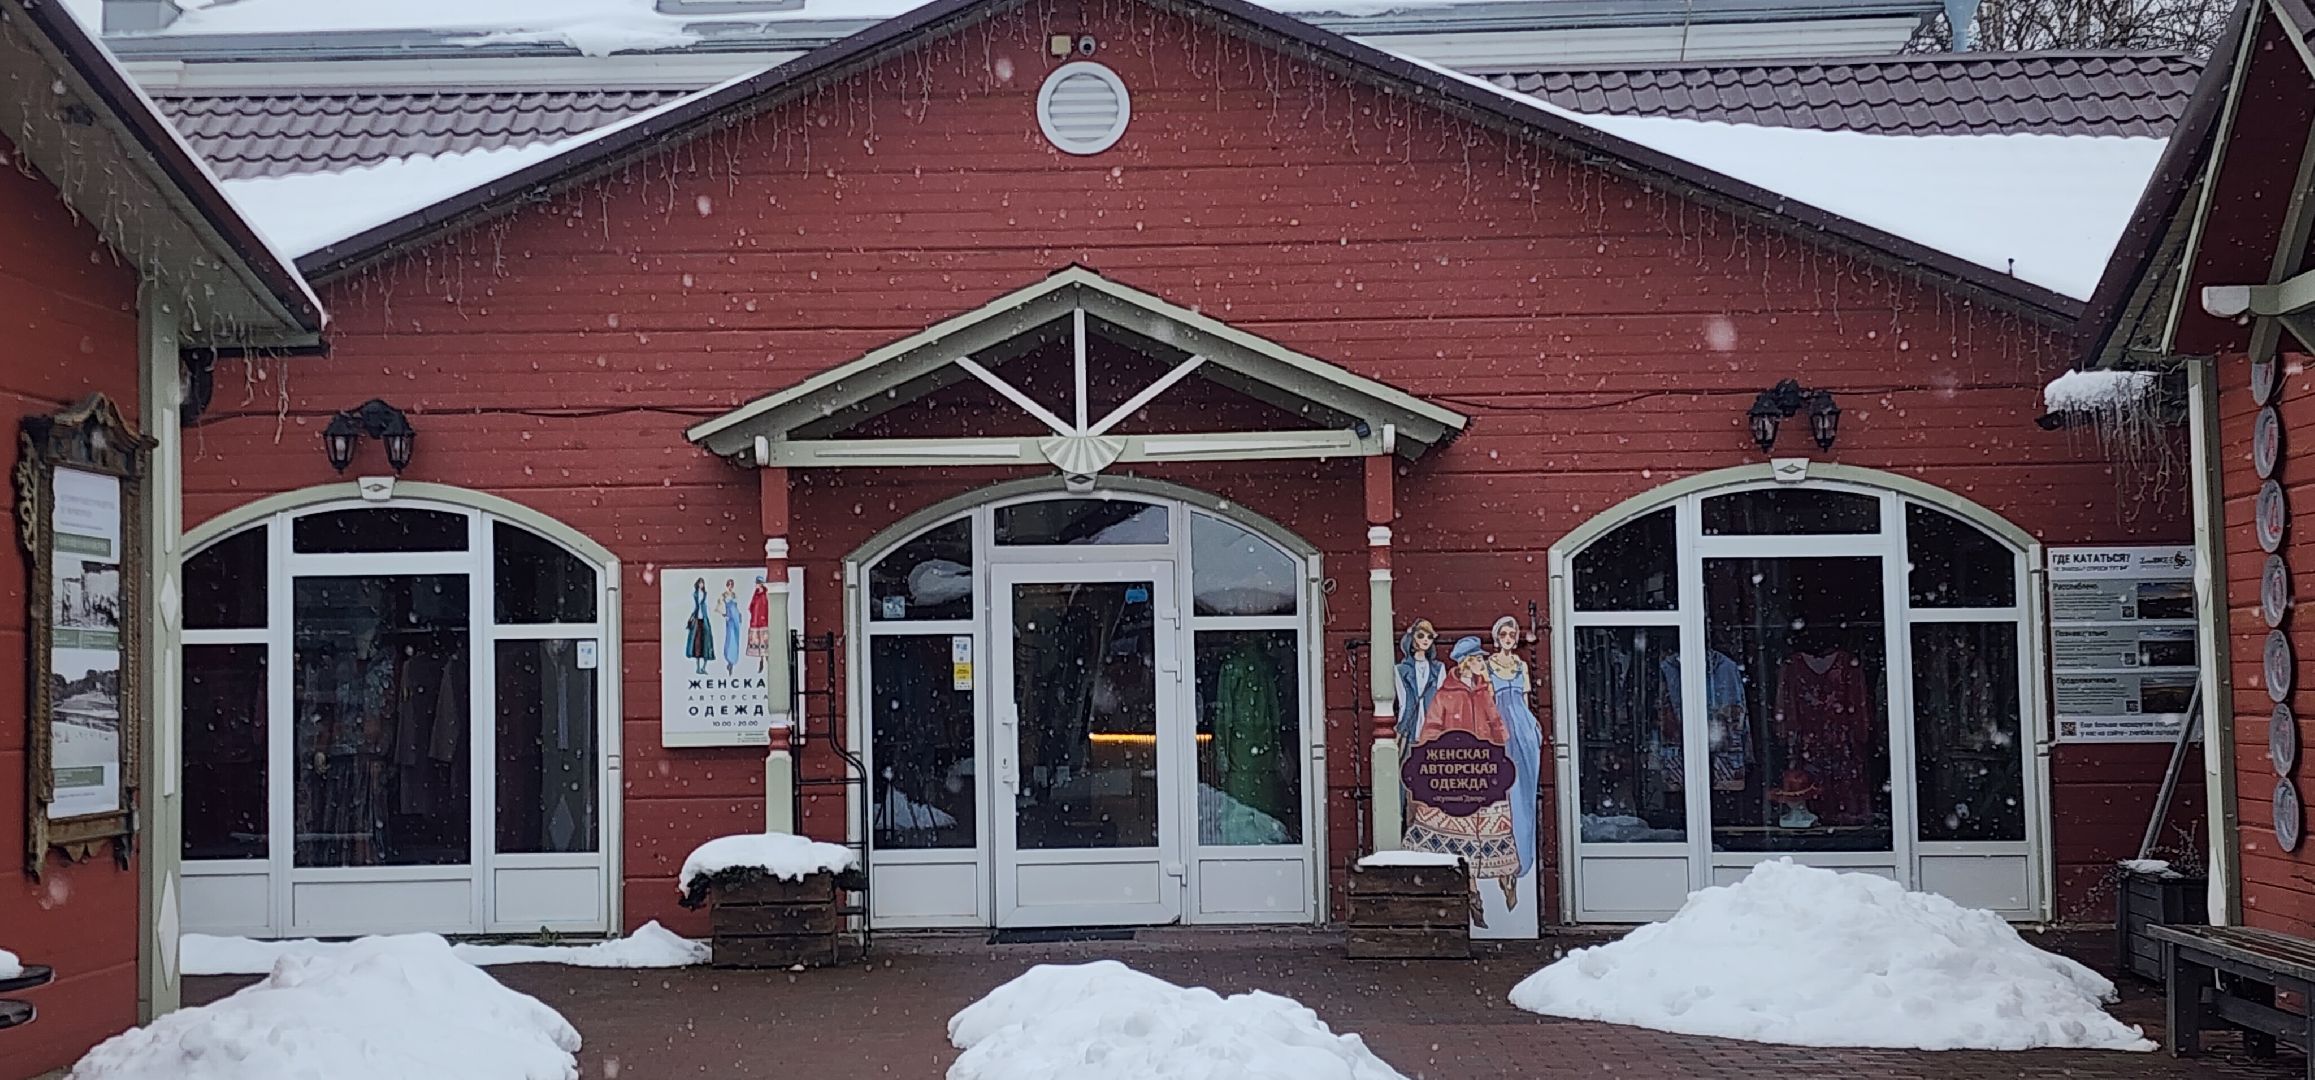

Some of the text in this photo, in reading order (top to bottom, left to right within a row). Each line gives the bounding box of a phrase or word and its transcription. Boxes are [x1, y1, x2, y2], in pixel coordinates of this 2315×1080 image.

[2052, 553, 2131, 565] ГДЕ КАТАТЬСЯ?
[688, 679, 766, 690] ЖЕНСКА
[688, 704, 764, 717] ОДЕЖД
[1426, 748, 1490, 760] ЖЕНСКАЯ
[1419, 762, 1498, 775] АВТОРСКАЯ
[1429, 778, 1489, 792] ОДЕЖДА
